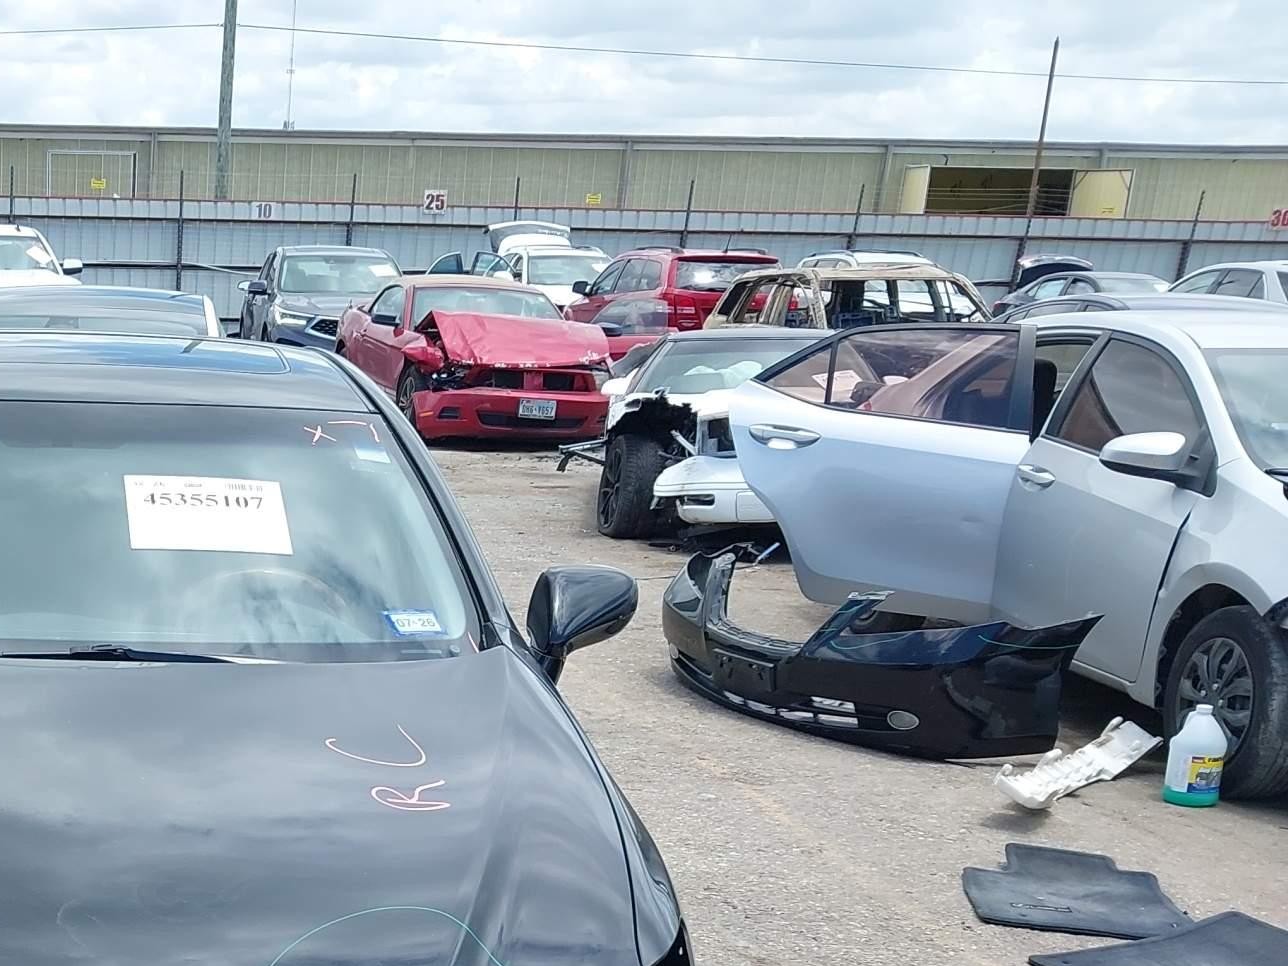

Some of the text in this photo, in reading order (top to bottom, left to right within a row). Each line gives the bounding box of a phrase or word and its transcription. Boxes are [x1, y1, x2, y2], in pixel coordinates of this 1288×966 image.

[256, 203, 273, 219] 10
[425, 193, 445, 211] 25
[143, 492, 263, 510] 45355107
